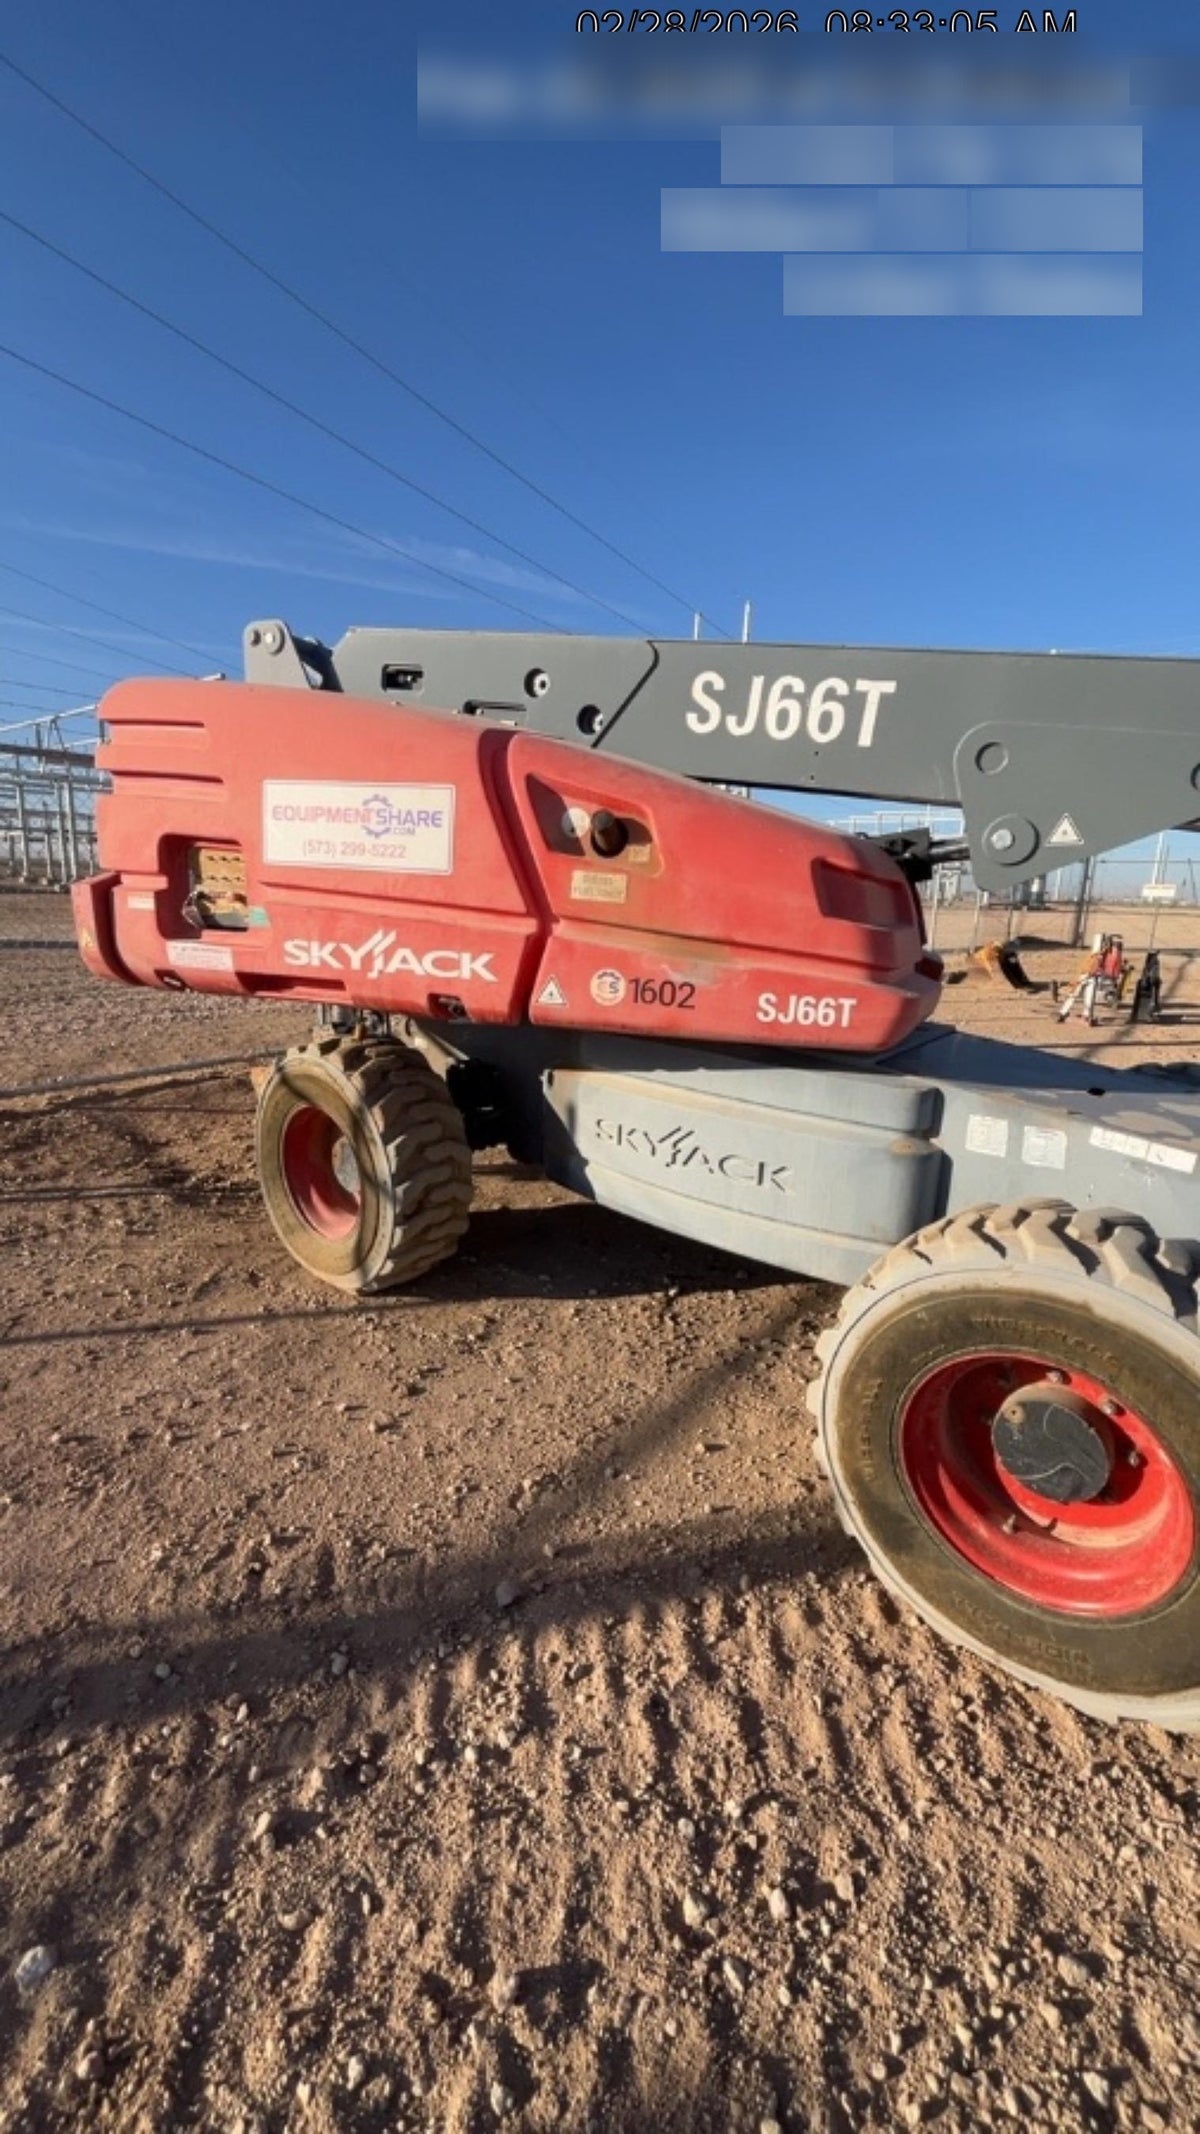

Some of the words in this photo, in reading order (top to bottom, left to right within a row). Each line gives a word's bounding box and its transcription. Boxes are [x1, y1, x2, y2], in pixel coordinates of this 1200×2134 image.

[685, 670, 897, 747] SJ66T
[303, 840, 337, 857] (573)
[283, 928, 498, 982] SKYJACK
[629, 978, 696, 1009] 1602
[756, 993, 857, 1028] SJ66T
[595, 1118, 791, 1194] SKYJACK
